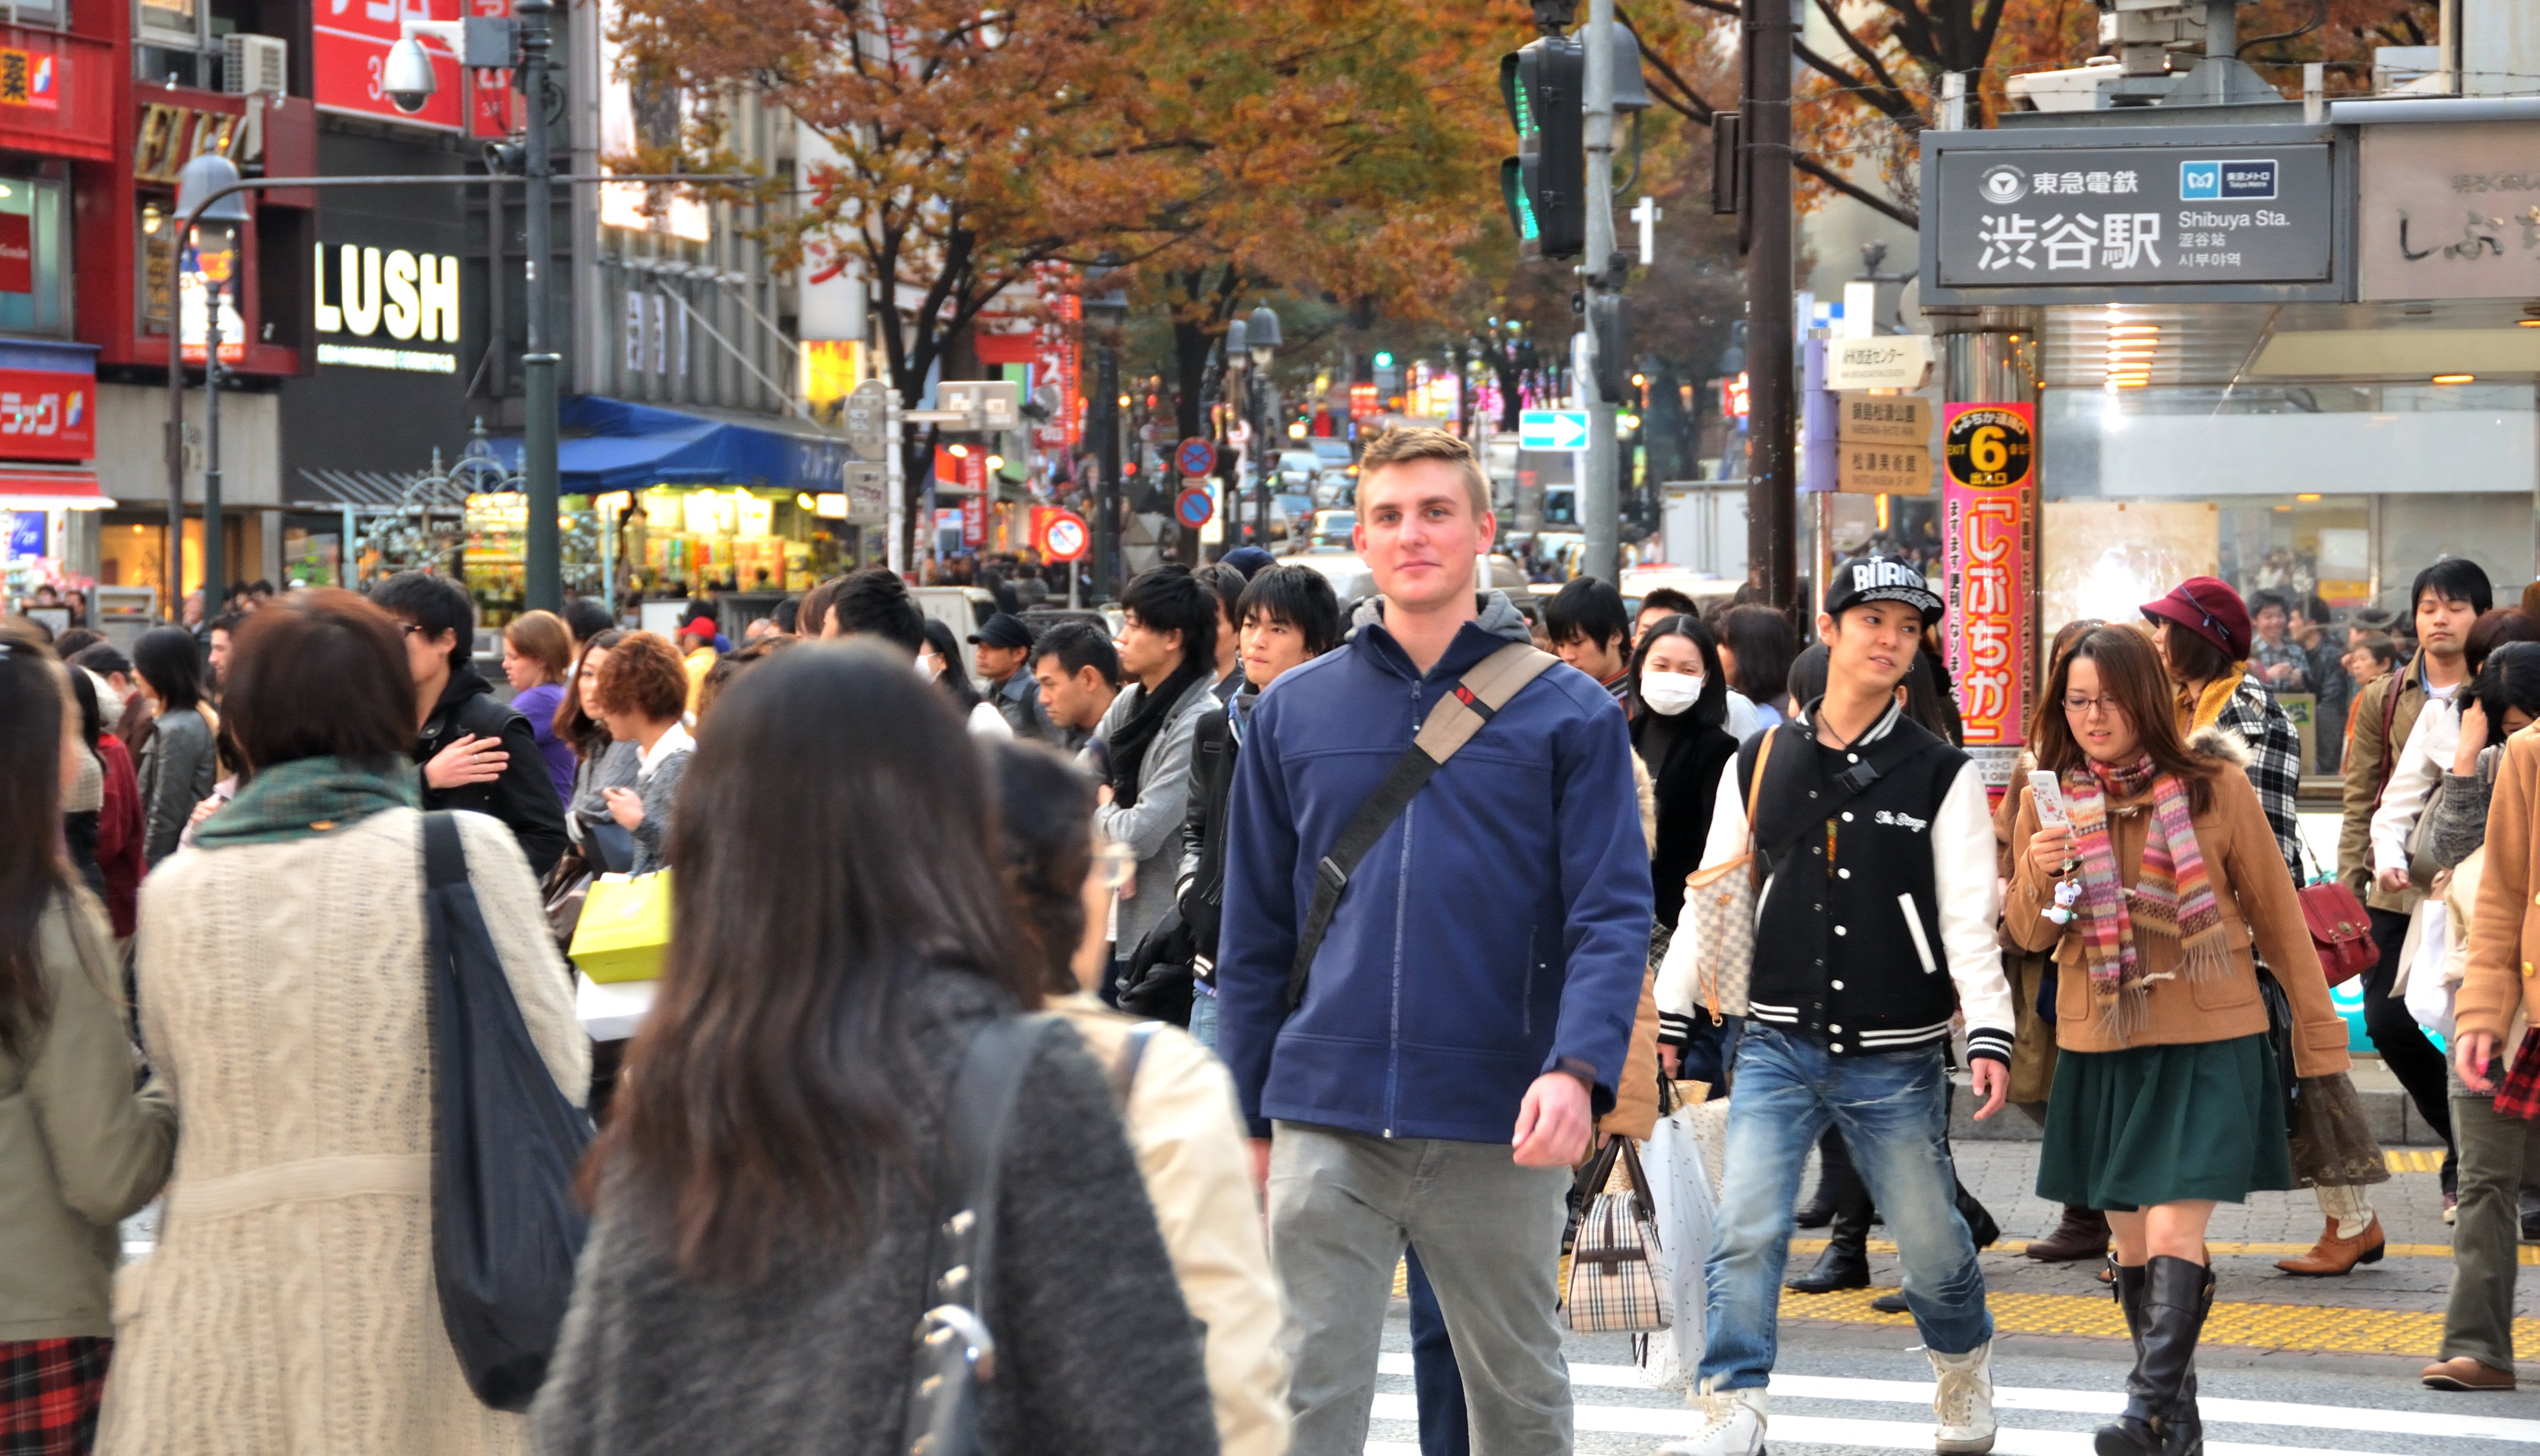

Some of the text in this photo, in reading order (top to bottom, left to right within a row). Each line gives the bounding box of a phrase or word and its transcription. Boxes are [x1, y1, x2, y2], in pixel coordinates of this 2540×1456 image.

[2032, 171, 2139, 194] 東急電鉄
[2226, 172, 2271, 181] 東京メトロ
[2179, 209, 2291, 231] Shibuya Sta.
[1978, 212, 2161, 270] 渋谷駅
[2179, 252, 2242, 267] 시부야역
[314, 241, 460, 343] LUSH
[0, 392, 59, 436] ラッグ
[1969, 425, 2008, 472] 6
